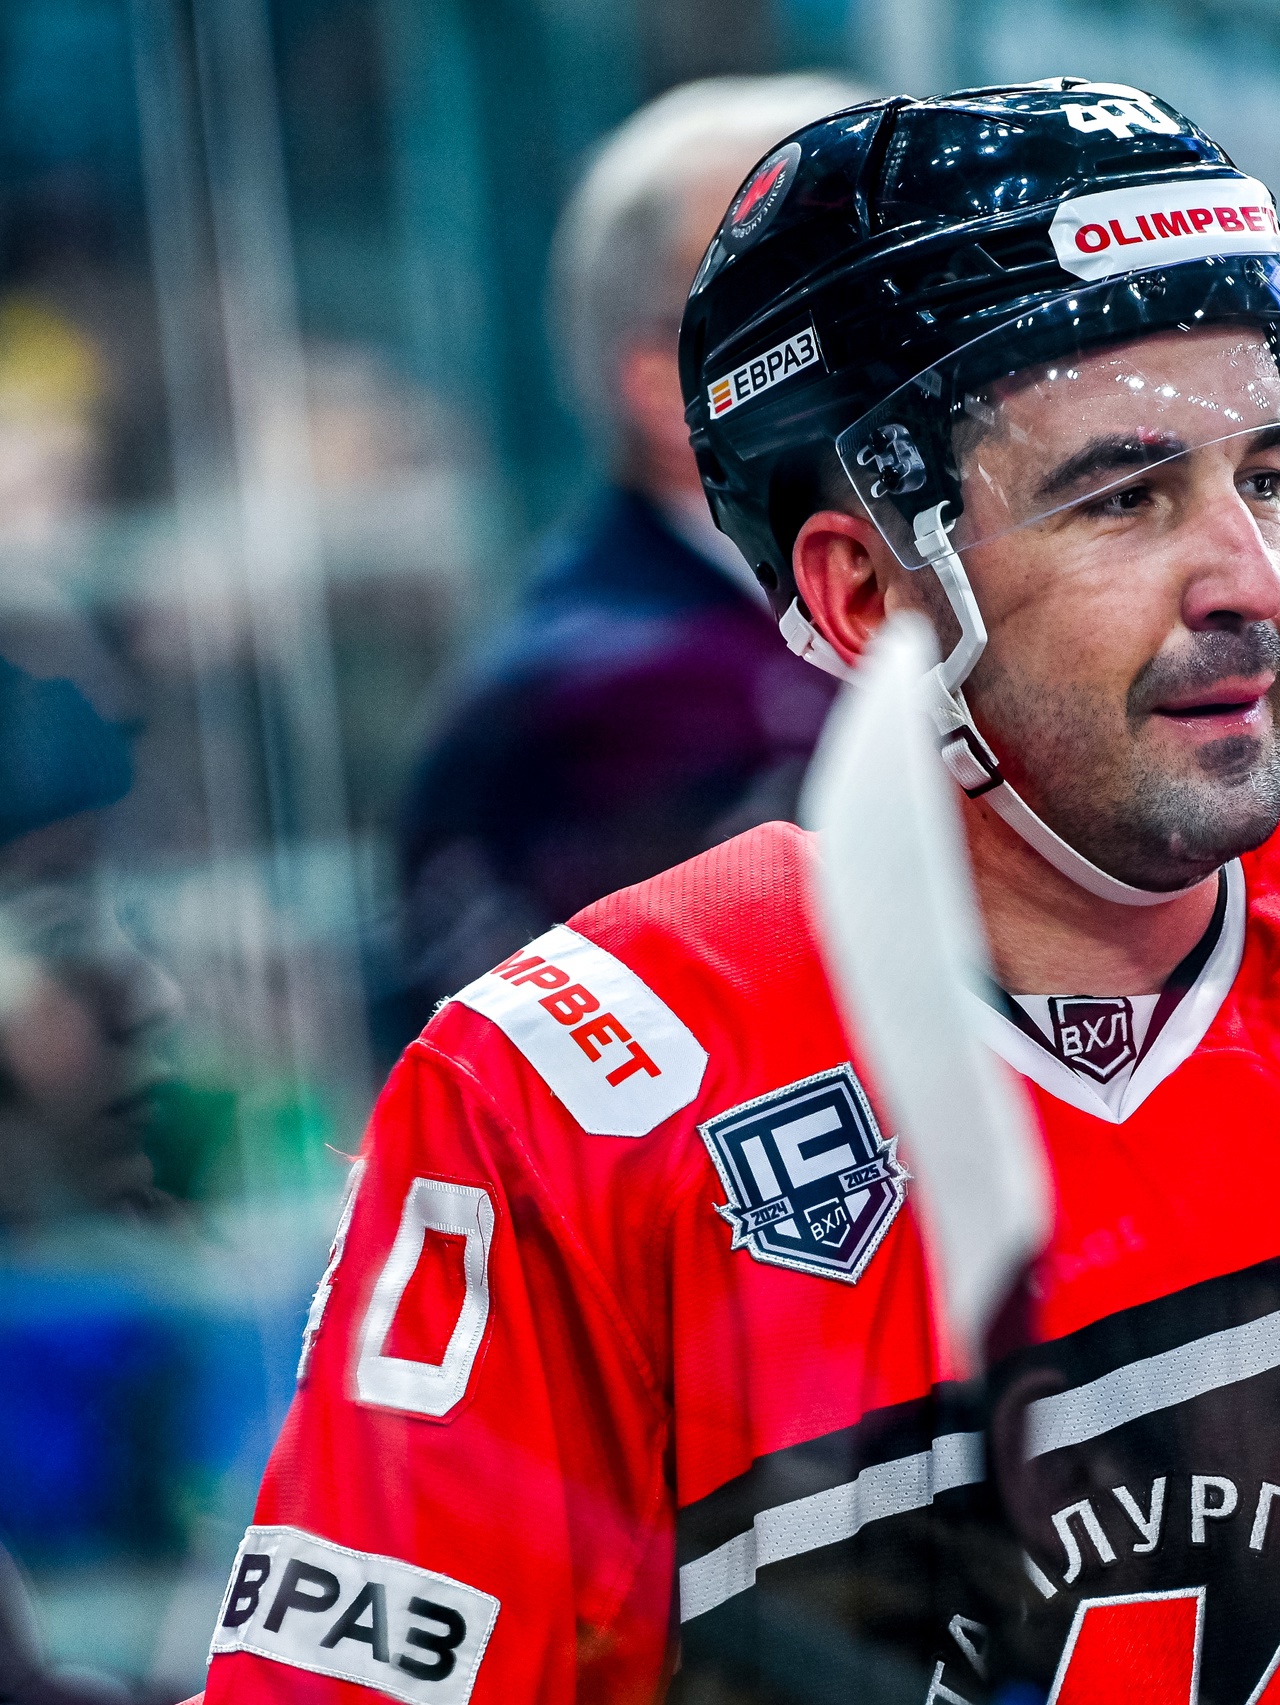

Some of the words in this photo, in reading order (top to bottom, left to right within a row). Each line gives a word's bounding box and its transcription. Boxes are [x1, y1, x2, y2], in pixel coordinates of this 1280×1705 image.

[1074, 206, 1279, 254] OLIMPBET
[733, 333, 815, 401] ЕВРАЗ
[490, 949, 663, 1088] MPBET
[1060, 1012, 1127, 1057] ВХЛ
[843, 1163, 880, 1189] 2025
[751, 1201, 789, 1225] 2024
[810, 1206, 847, 1241] ВХЛ
[297, 1159, 495, 1417] 0
[222, 1553, 467, 1682] ВРАЗ
